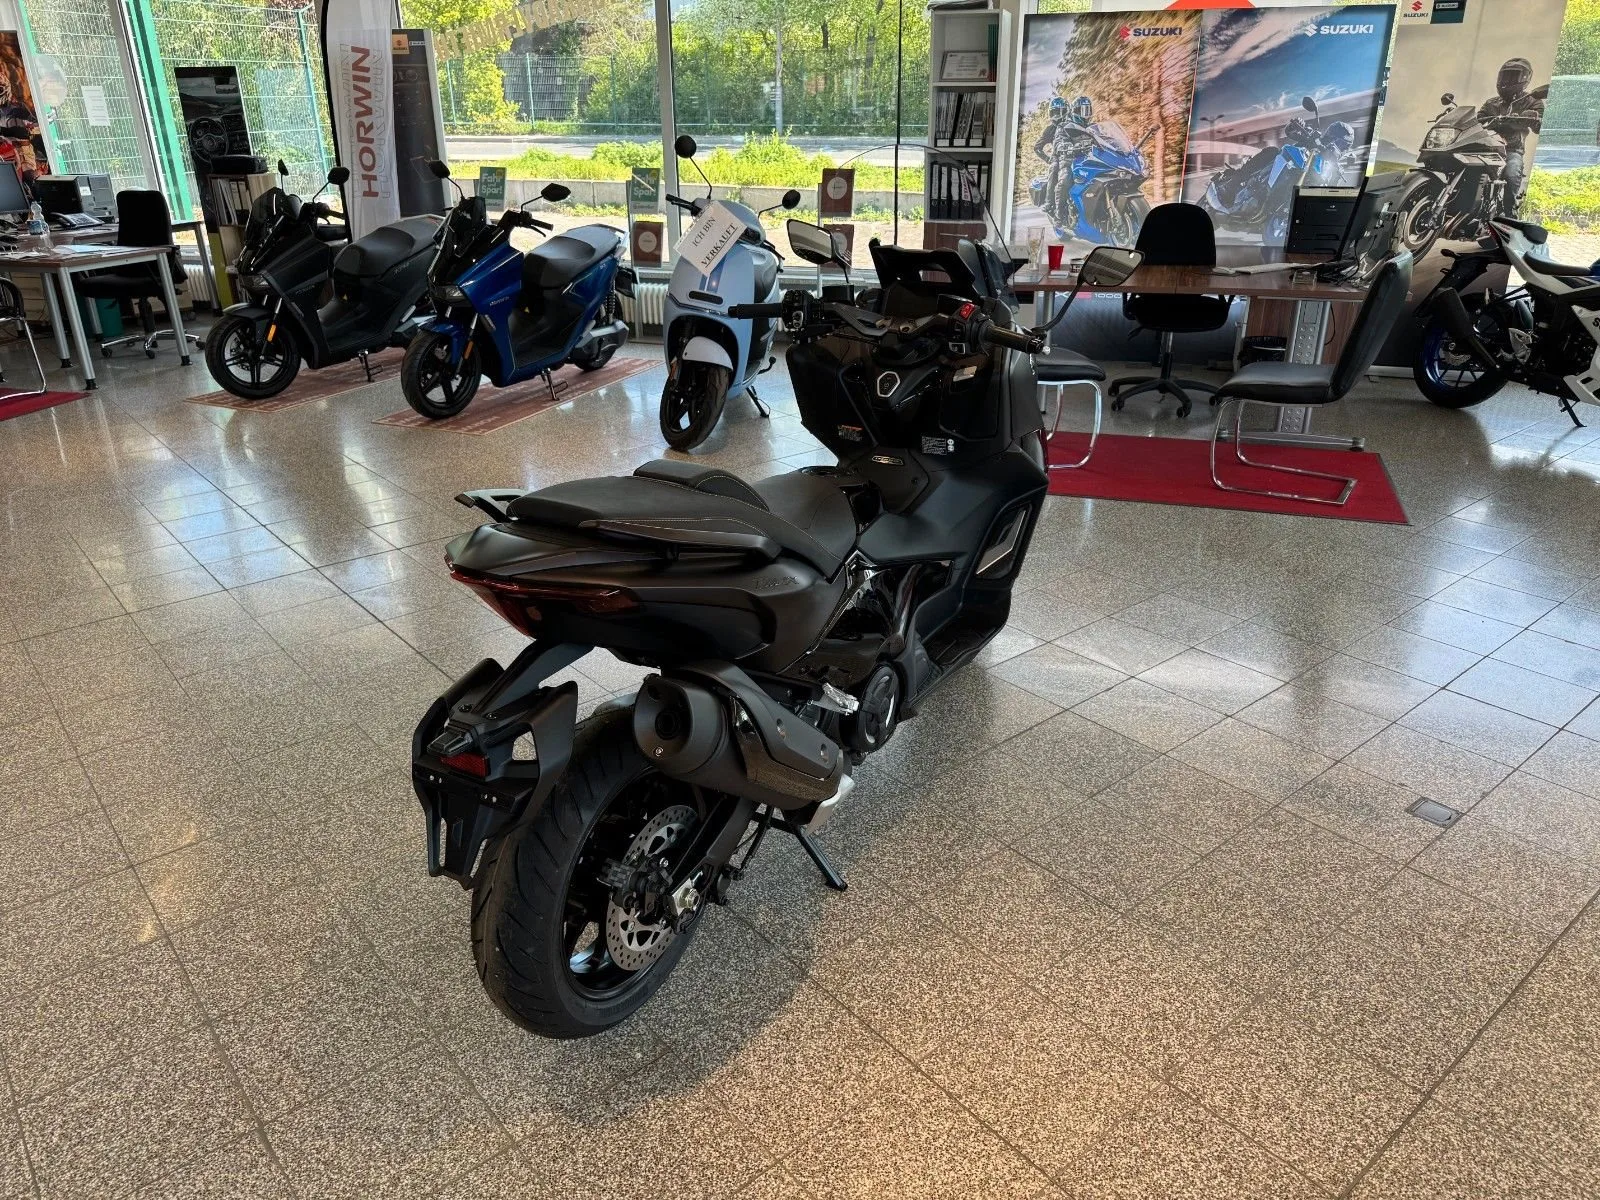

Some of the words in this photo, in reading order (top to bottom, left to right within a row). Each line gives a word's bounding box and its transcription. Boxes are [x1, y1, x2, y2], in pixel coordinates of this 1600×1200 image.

[1133, 27, 1182, 36] SUZUKI
[1320, 25, 1374, 34] SUZUKI
[350, 46, 380, 198] HORWIN
[481, 184, 503, 196] Spar!
[692, 231, 706, 247] ICH
[703, 217, 716, 233] BIN
[701, 223, 736, 266] VERKAUFT
